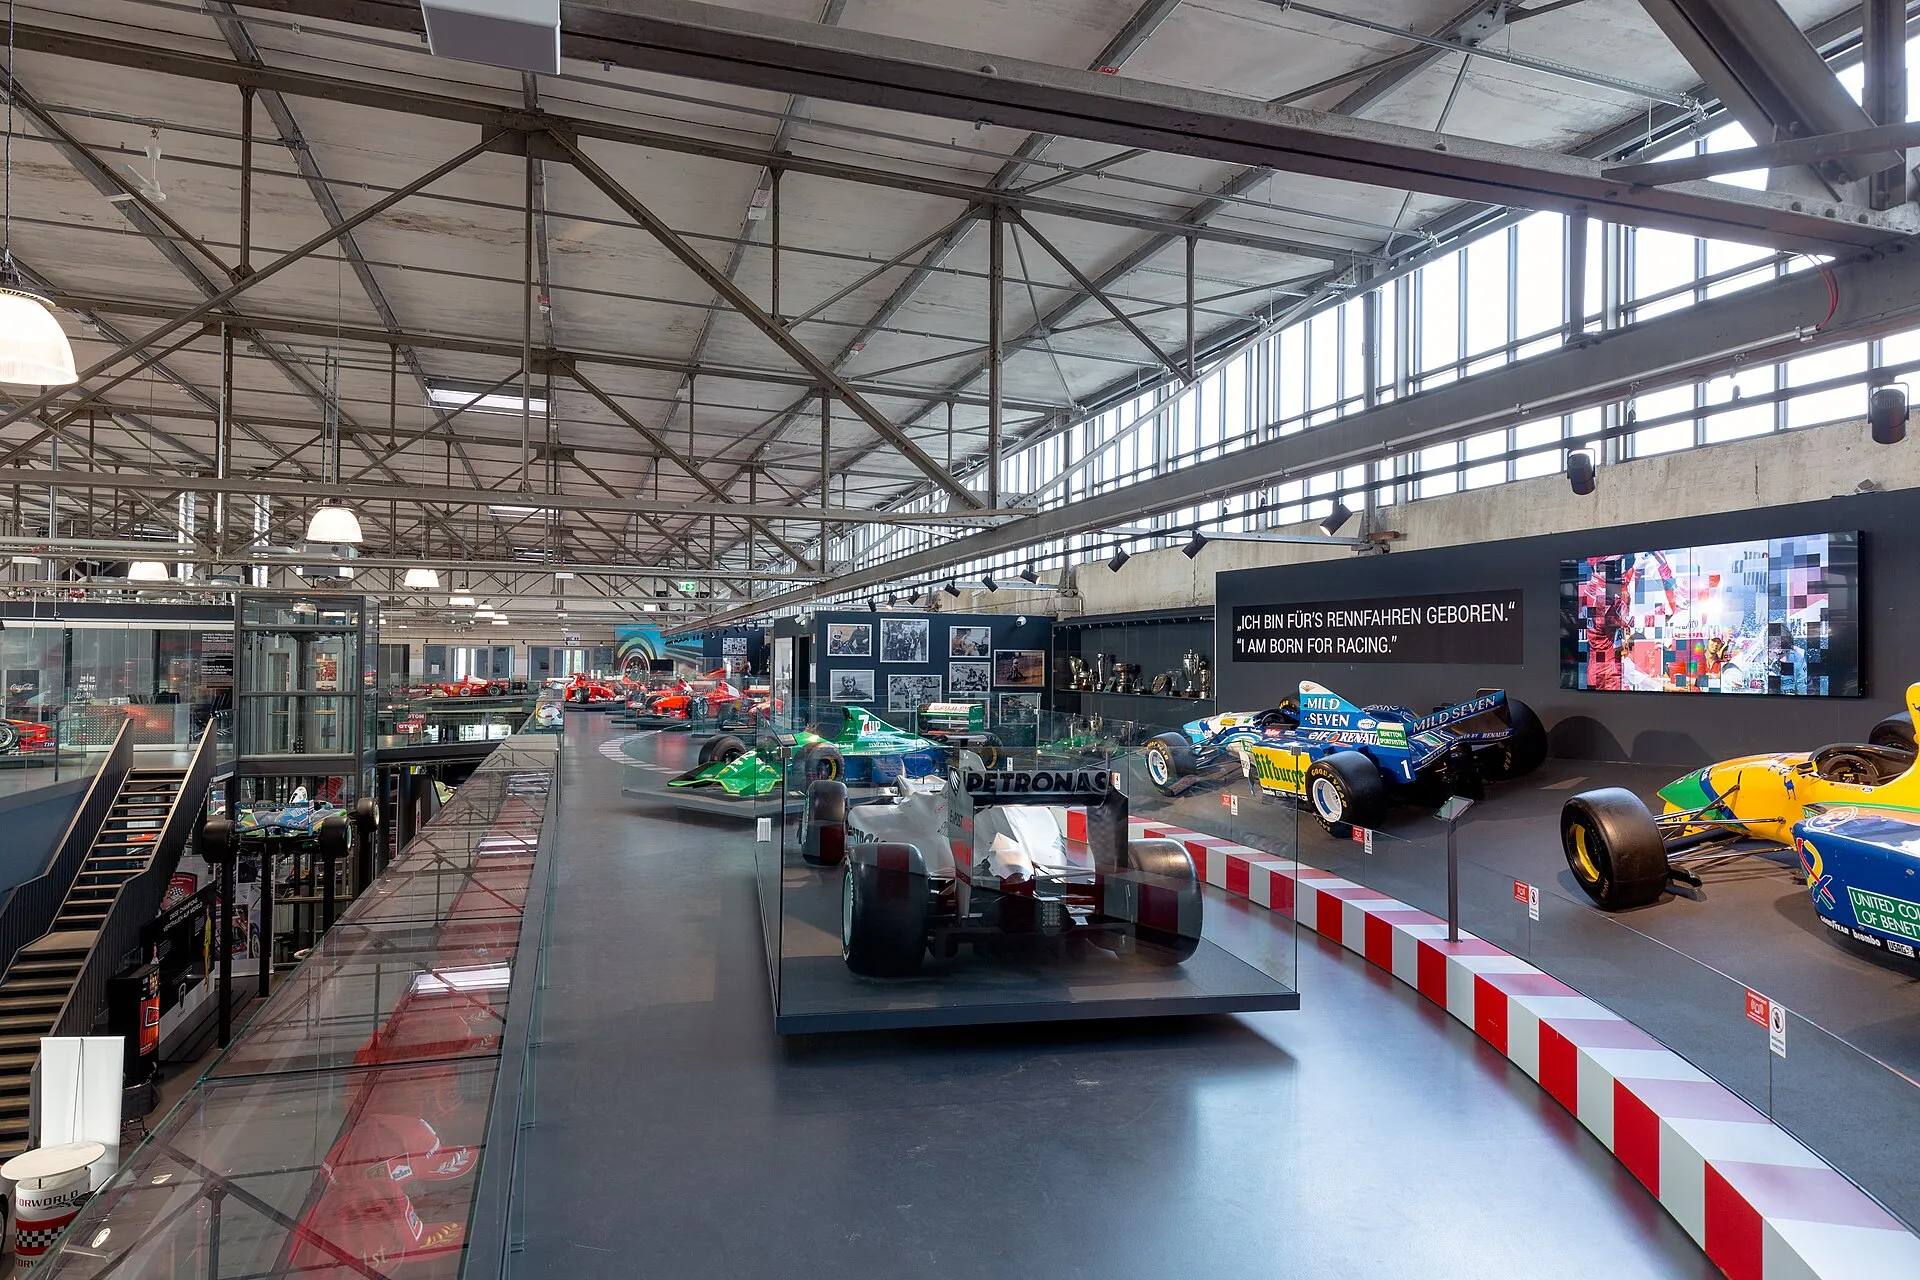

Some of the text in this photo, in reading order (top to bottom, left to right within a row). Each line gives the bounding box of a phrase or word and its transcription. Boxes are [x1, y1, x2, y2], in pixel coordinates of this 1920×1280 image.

[1264, 613, 1284, 629] BIN
[1327, 607, 1422, 628] RENNFAHREN
[1247, 638, 1266, 653] AM
[1269, 638, 1304, 654] BORN
[1307, 637, 1333, 654] FOR
[1307, 697, 1340, 710] MILD
[1309, 712, 1350, 727] SEVEN
[1412, 695, 1496, 733] MILD SEVEN
[1481, 731, 1510, 739] RENAULT
[1400, 759, 1412, 780] 1
[967, 771, 1108, 793] PETRONAS
[1311, 768, 1348, 808] GOODYEAR
[1851, 891, 1895, 914] UNITED
[1861, 910, 1878, 926] OF
[1852, 929, 1881, 947] brembo
